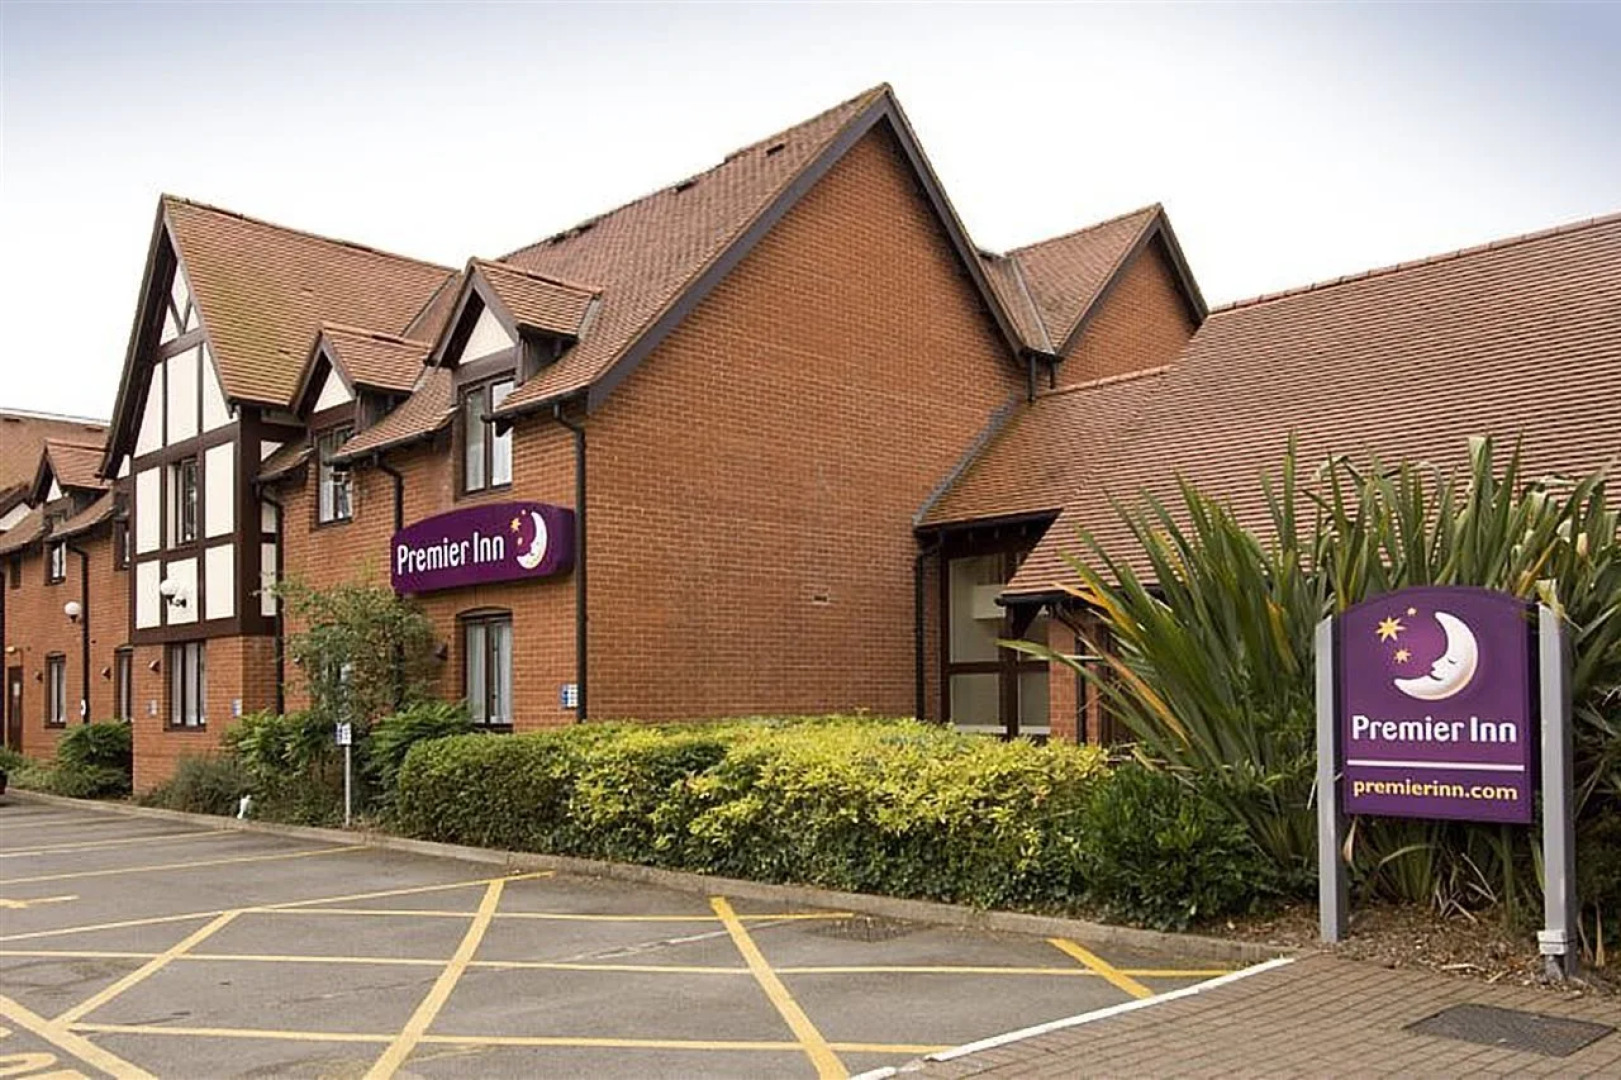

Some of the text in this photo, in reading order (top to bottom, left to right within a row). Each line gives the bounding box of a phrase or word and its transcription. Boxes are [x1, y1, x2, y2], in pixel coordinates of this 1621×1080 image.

[397, 531, 504, 576] Premier Inn
[1352, 715, 1517, 743] Premier Inn
[1353, 778, 1518, 800] premierinn.com
